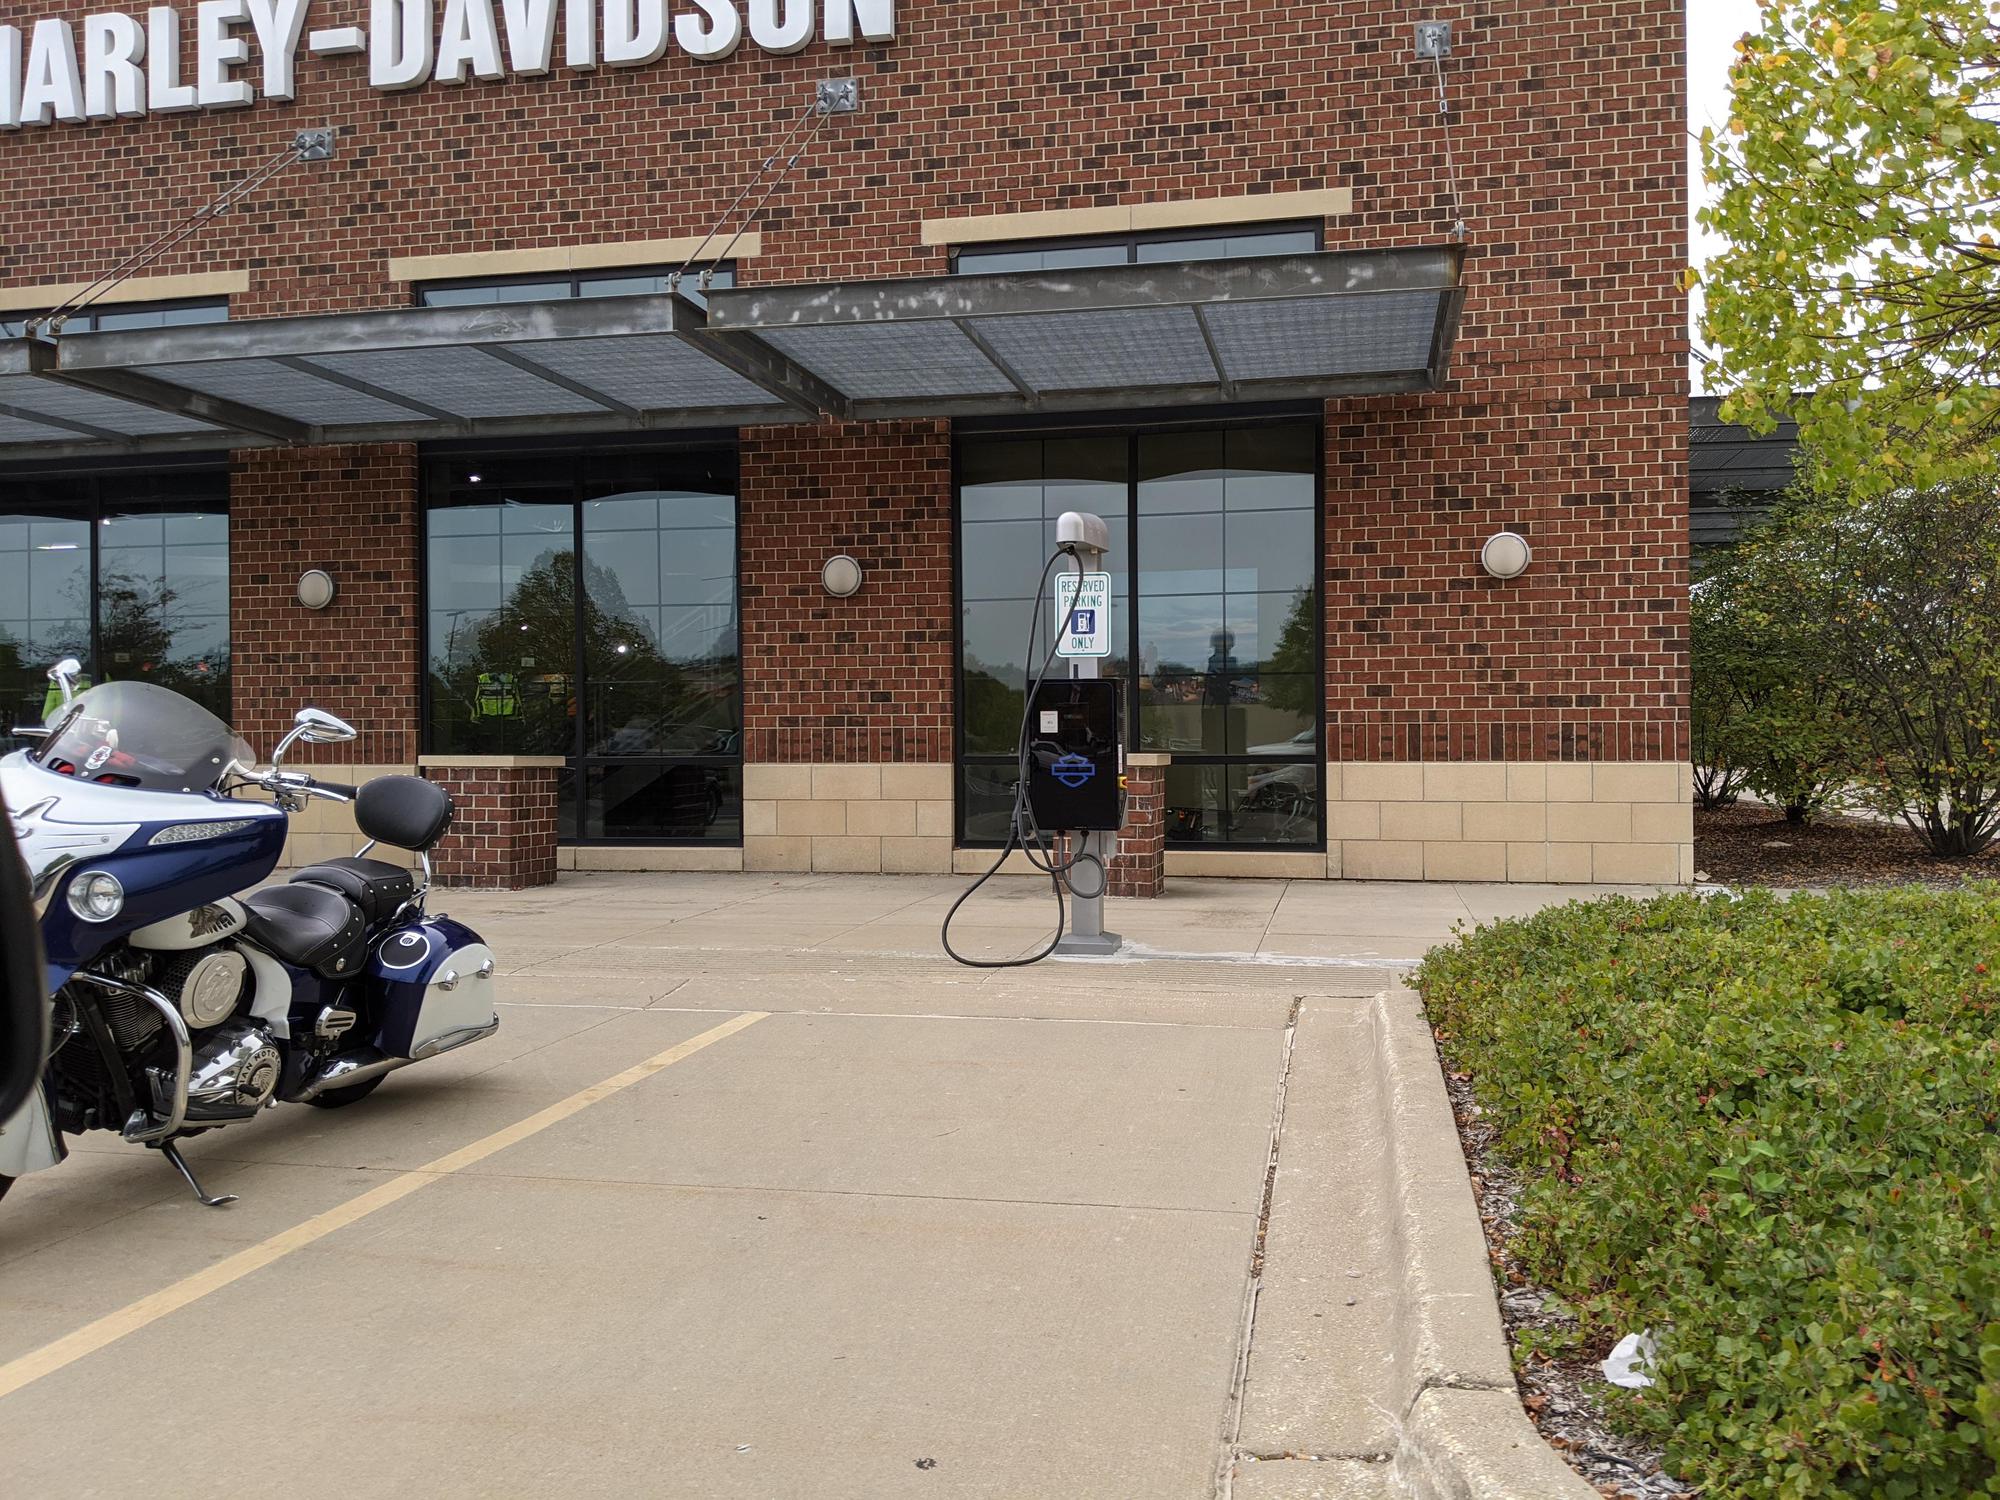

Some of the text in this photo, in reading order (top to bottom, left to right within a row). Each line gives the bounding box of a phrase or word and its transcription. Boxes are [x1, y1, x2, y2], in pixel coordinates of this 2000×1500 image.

[0, 0, 895, 130] ARLEY-DAVIDS
[1061, 580, 1105, 593] RESRVED
[1071, 637, 1095, 649] ONLY
